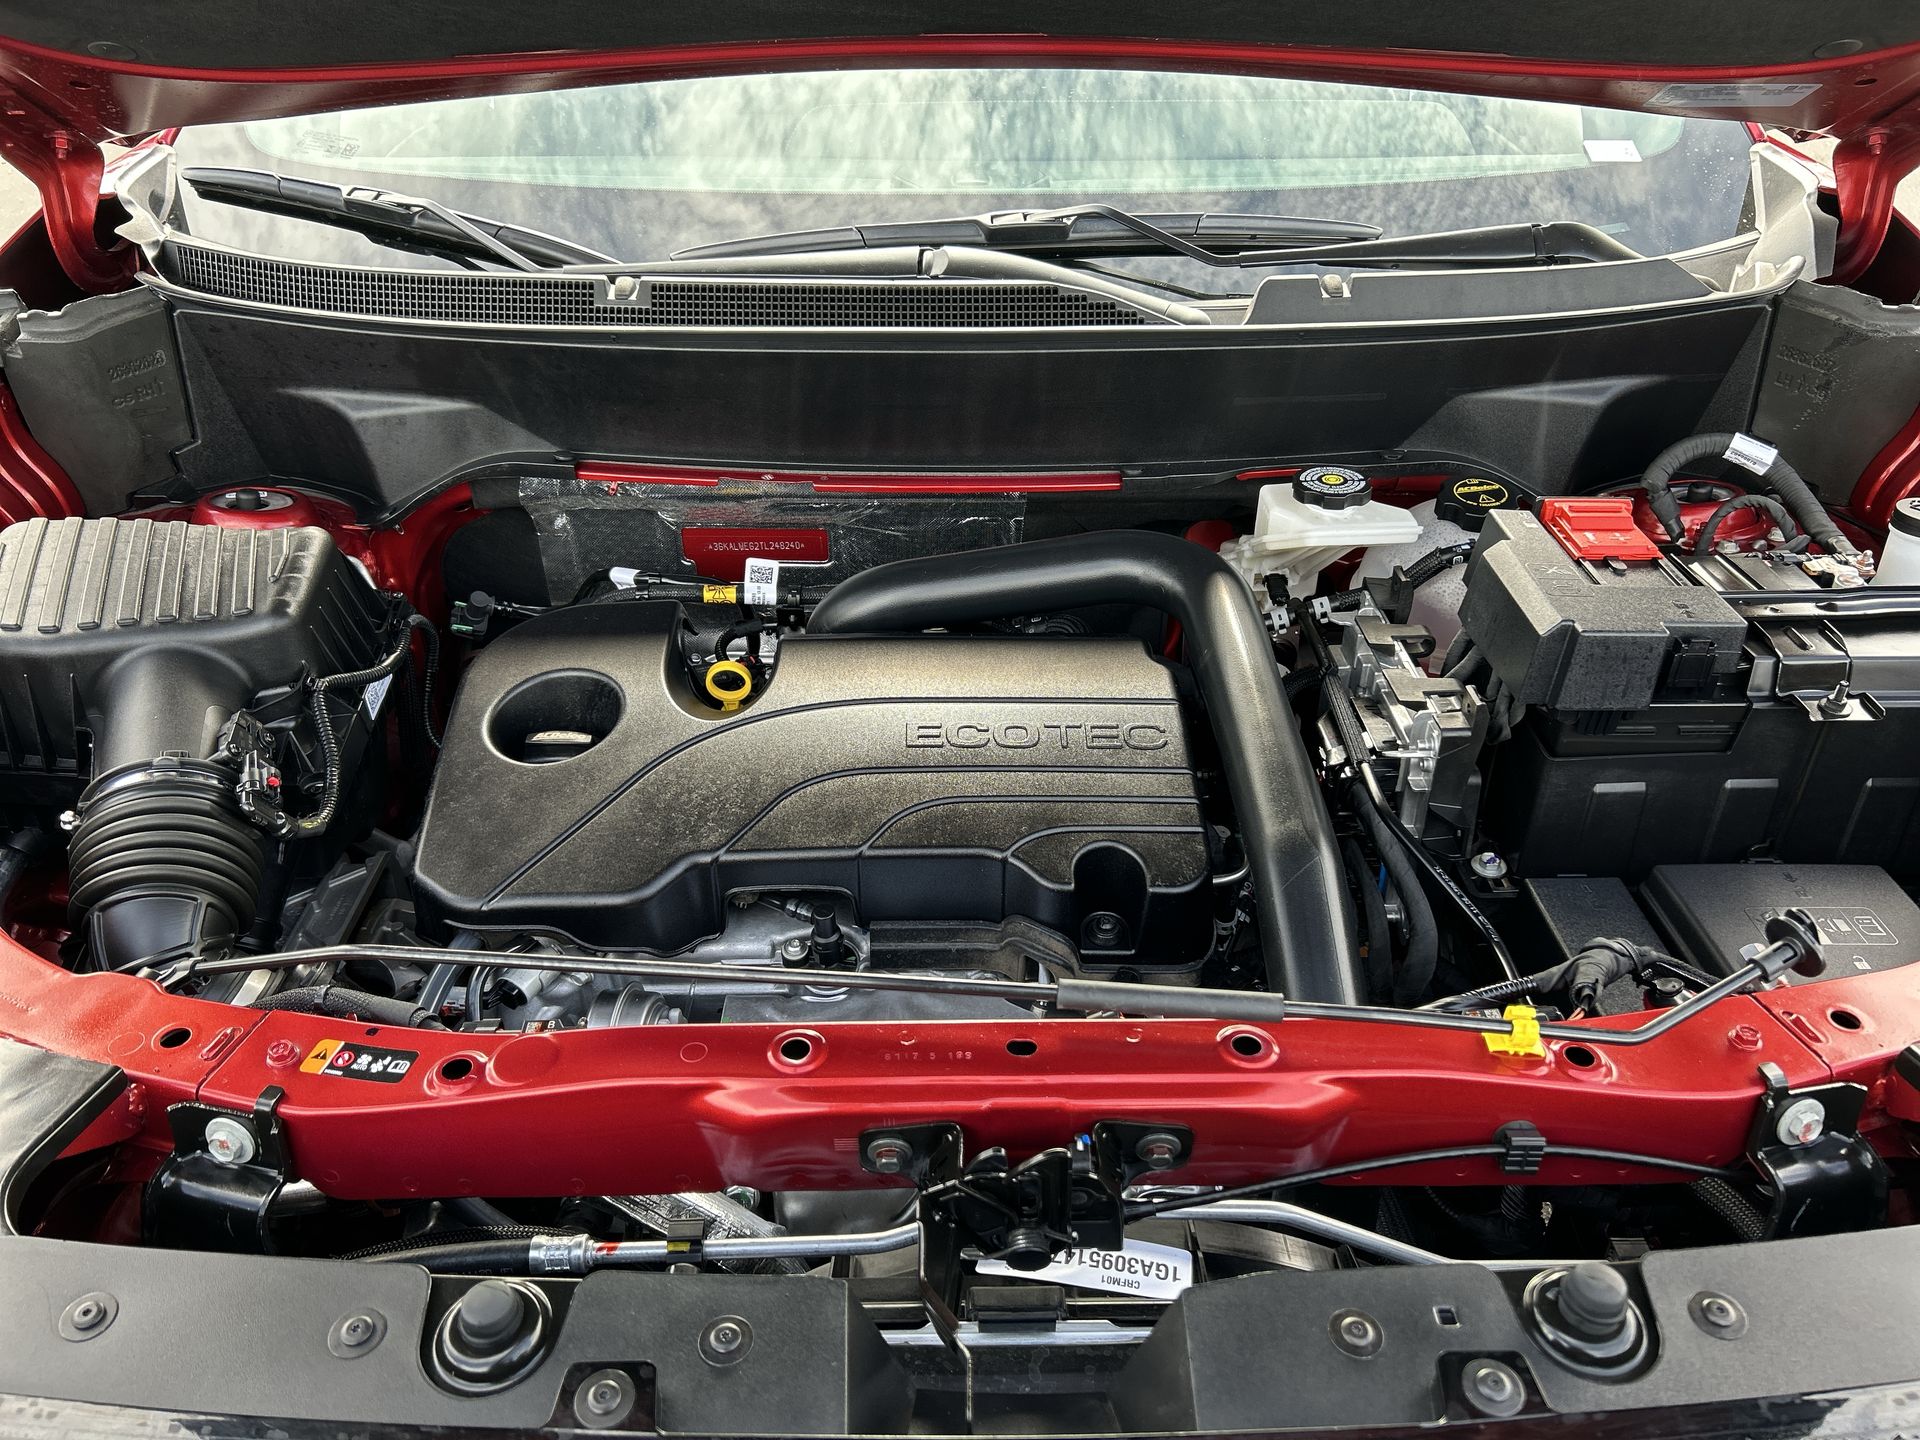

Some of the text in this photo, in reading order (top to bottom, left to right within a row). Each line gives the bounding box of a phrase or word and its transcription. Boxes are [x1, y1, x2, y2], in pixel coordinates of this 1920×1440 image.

[905, 721, 1169, 750] ECOTEC
[547, 1020, 556, 1029] B
[1101, 1274, 1141, 1290] CRFM01
